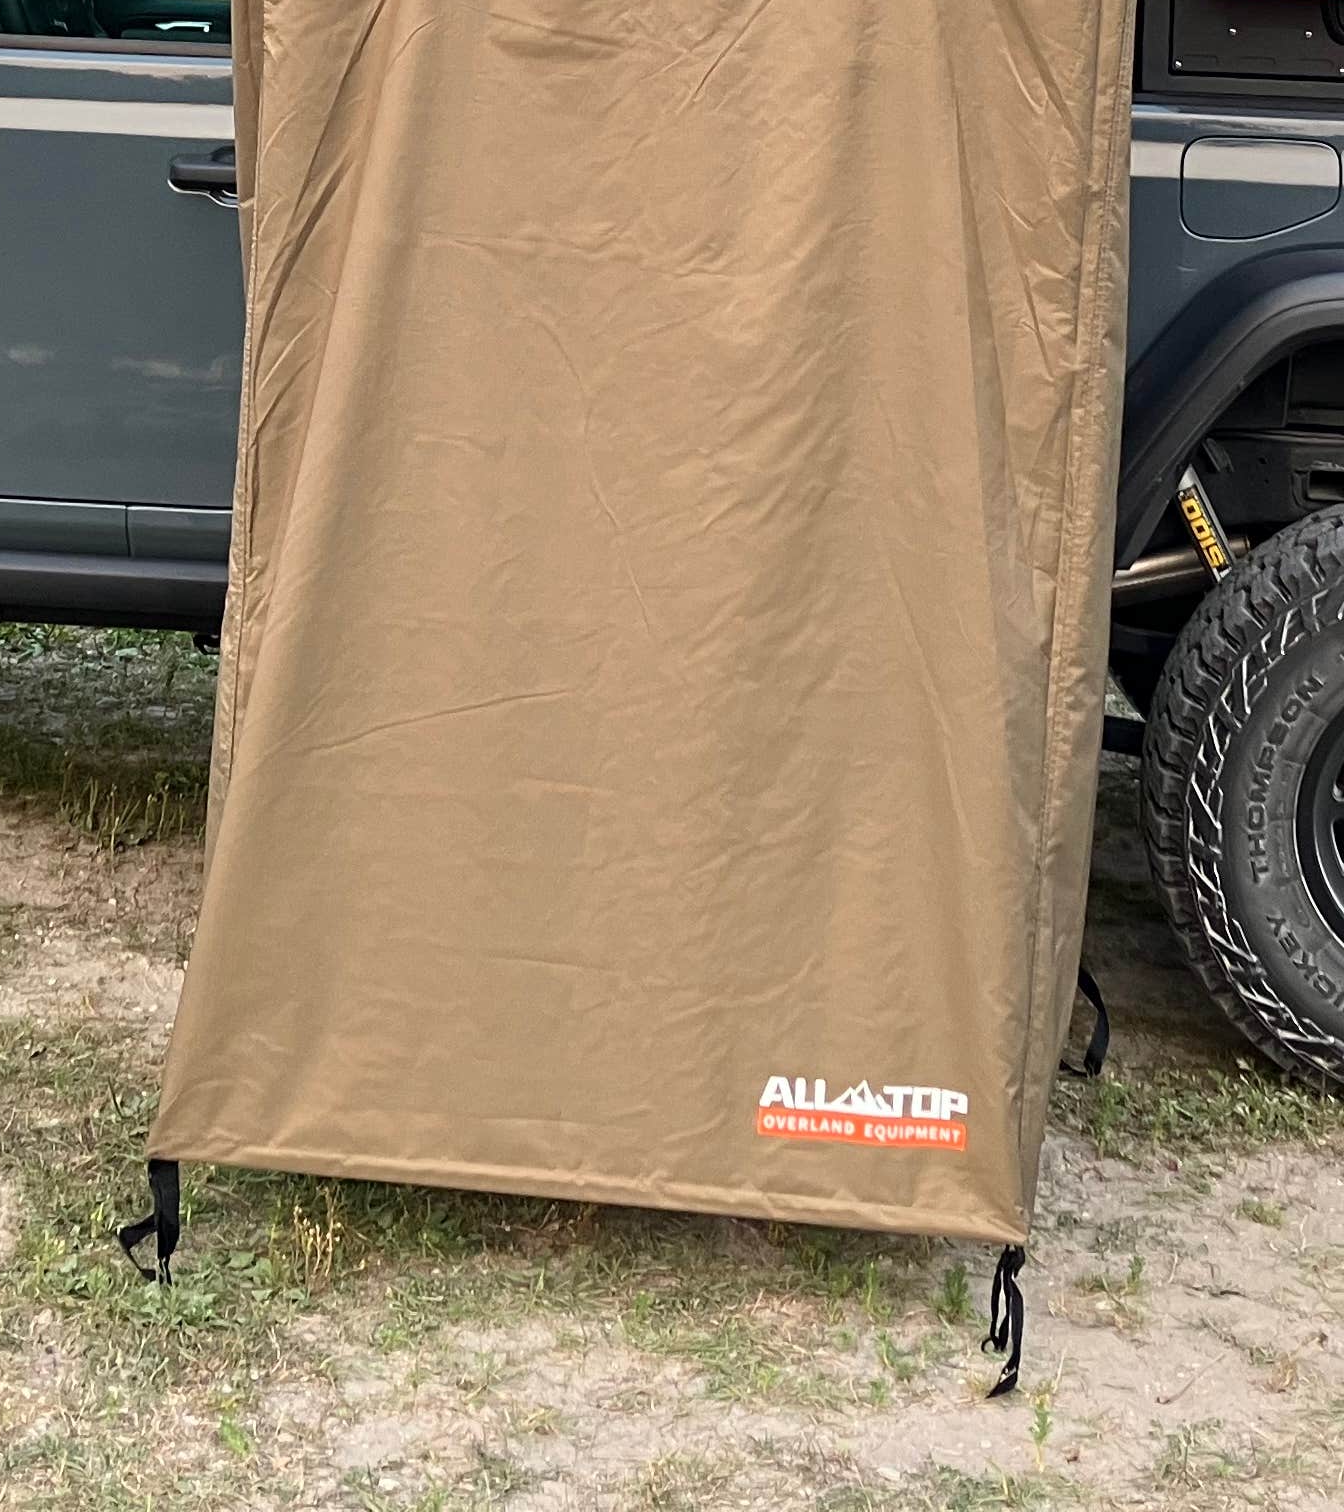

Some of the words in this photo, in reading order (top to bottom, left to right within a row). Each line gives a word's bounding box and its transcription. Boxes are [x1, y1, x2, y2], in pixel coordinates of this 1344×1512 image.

[1248, 675, 1326, 886] THOMPSON
[763, 1113, 856, 1137] OVERLAND
[863, 1123, 961, 1144] EQUIPMENT
